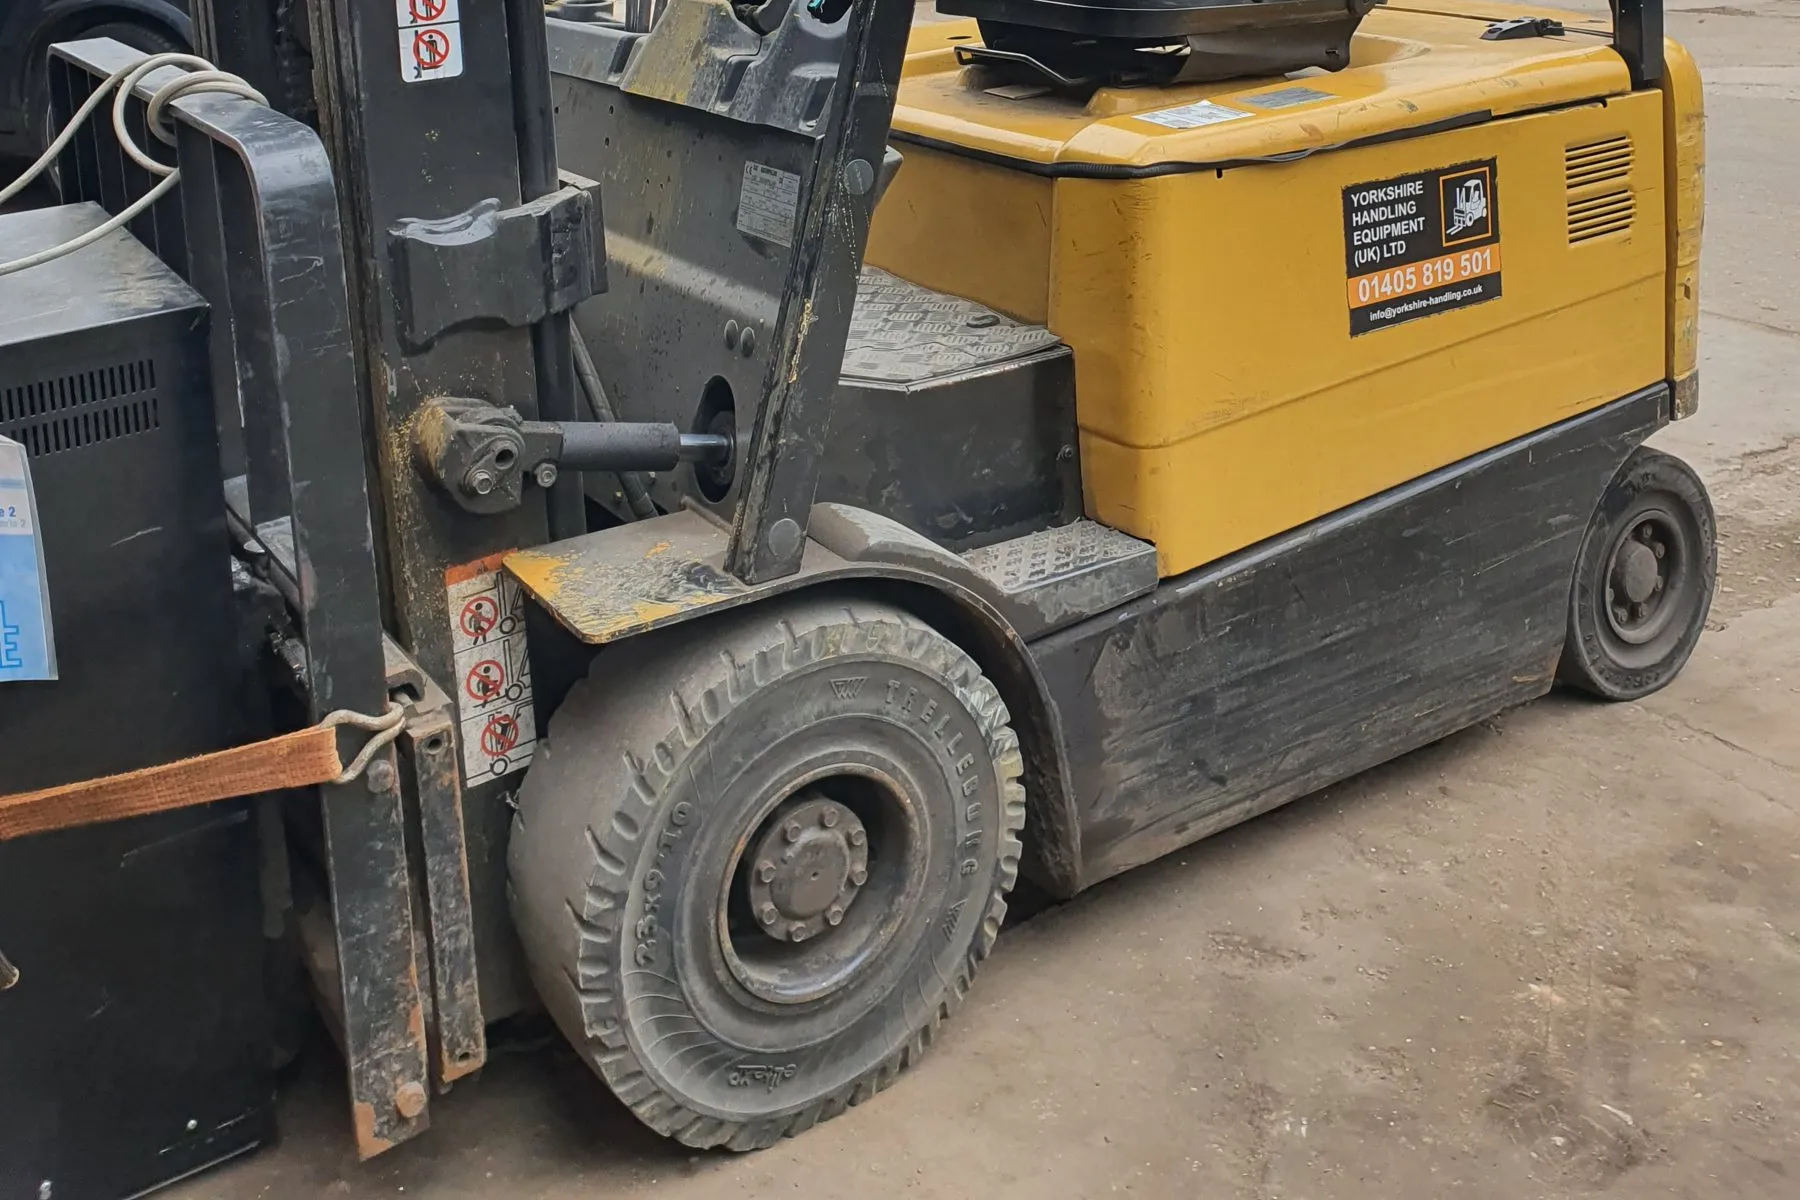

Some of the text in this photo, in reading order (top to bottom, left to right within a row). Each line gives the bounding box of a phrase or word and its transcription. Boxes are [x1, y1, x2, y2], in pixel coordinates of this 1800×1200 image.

[1351, 180, 1424, 208] YORKSHIRE
[1352, 200, 1417, 227] HANDLING
[1353, 216, 1426, 246] EQUIPMENT
[1354, 240, 1406, 268] (UK) LTD
[1358, 249, 1491, 302] 01405 819 501
[1369, 283, 1483, 322] info@yorkshire-handling.co.uk
[8, 505, 17, 518] 2
